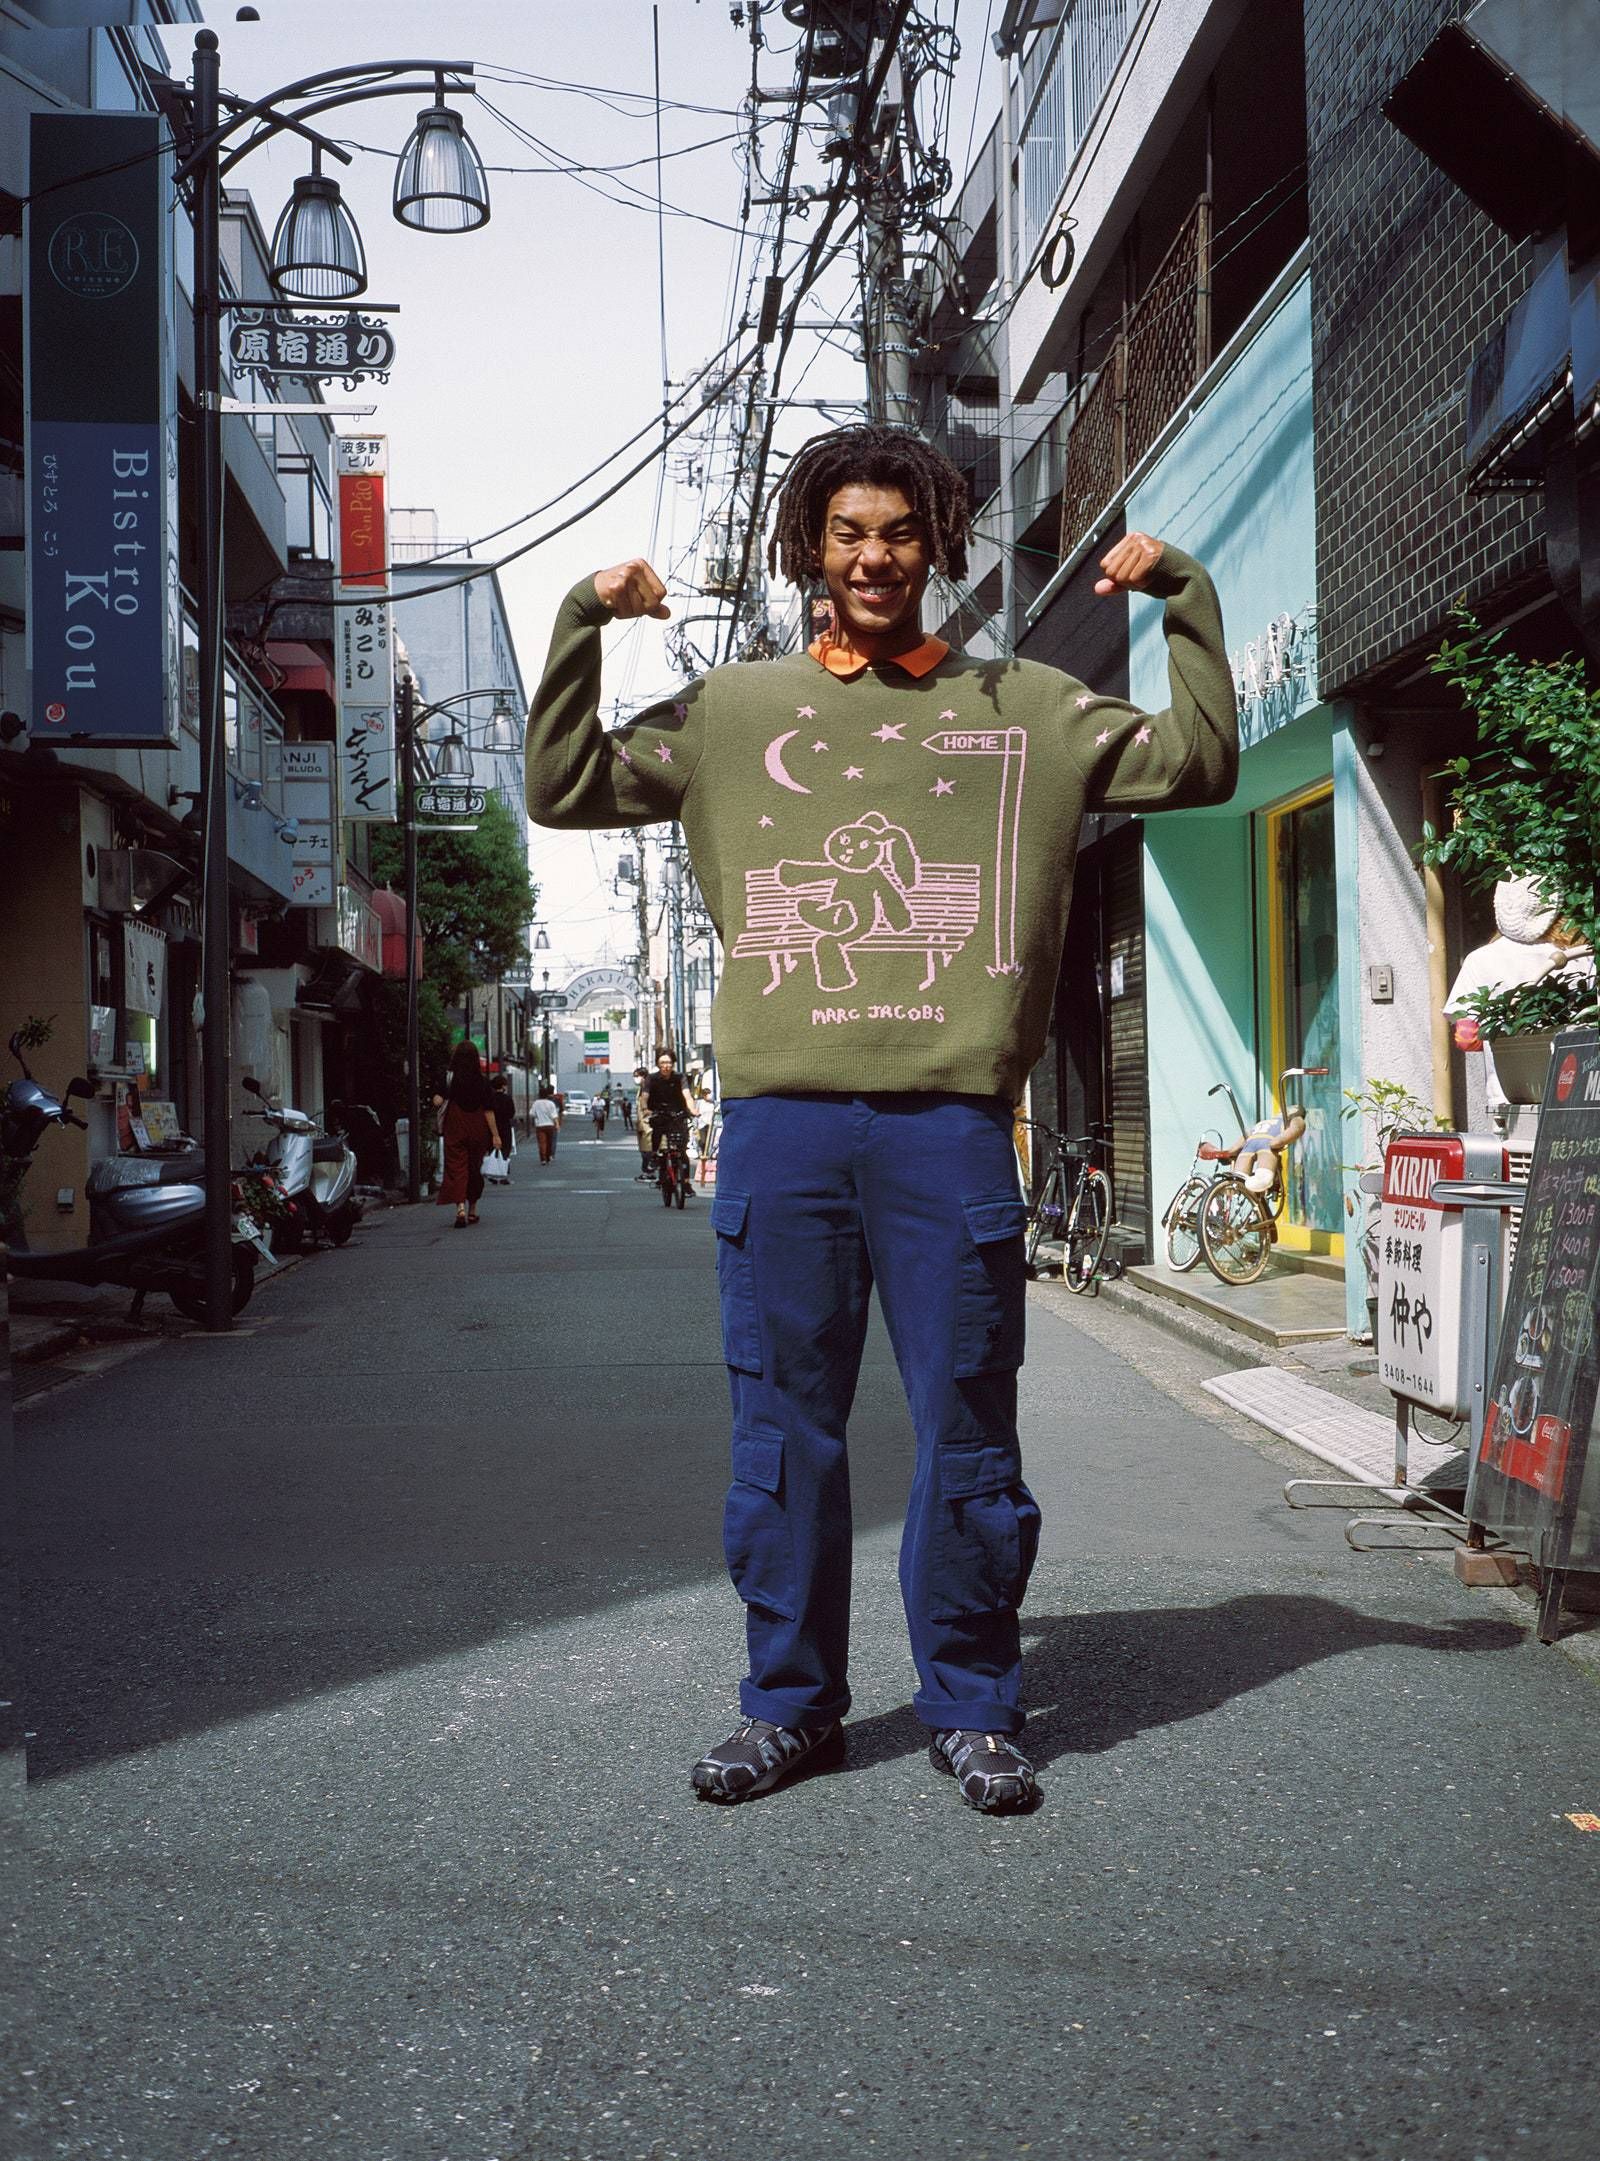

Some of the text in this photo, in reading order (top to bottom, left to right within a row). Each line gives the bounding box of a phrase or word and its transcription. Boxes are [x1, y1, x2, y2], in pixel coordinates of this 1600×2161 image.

[237, 329, 387, 366] 原宿通り
[341, 441, 381, 455] 波多野
[347, 456, 375, 468] ビル
[65, 449, 149, 691] Bistro Kou
[355, 606, 374, 679] みこし
[943, 736, 999, 750] HOME
[421, 796, 483, 811] 原宿通り
[811, 1004, 945, 1025] MARC JACOBS
[1388, 1155, 1441, 1199] KIRIN
[1394, 1208, 1427, 1231] キリンビール
[1385, 1236, 1422, 1272] 季節料理
[1390, 1280, 1432, 1354] 仲や
[1384, 1363, 1433, 1395] 3408-1644
